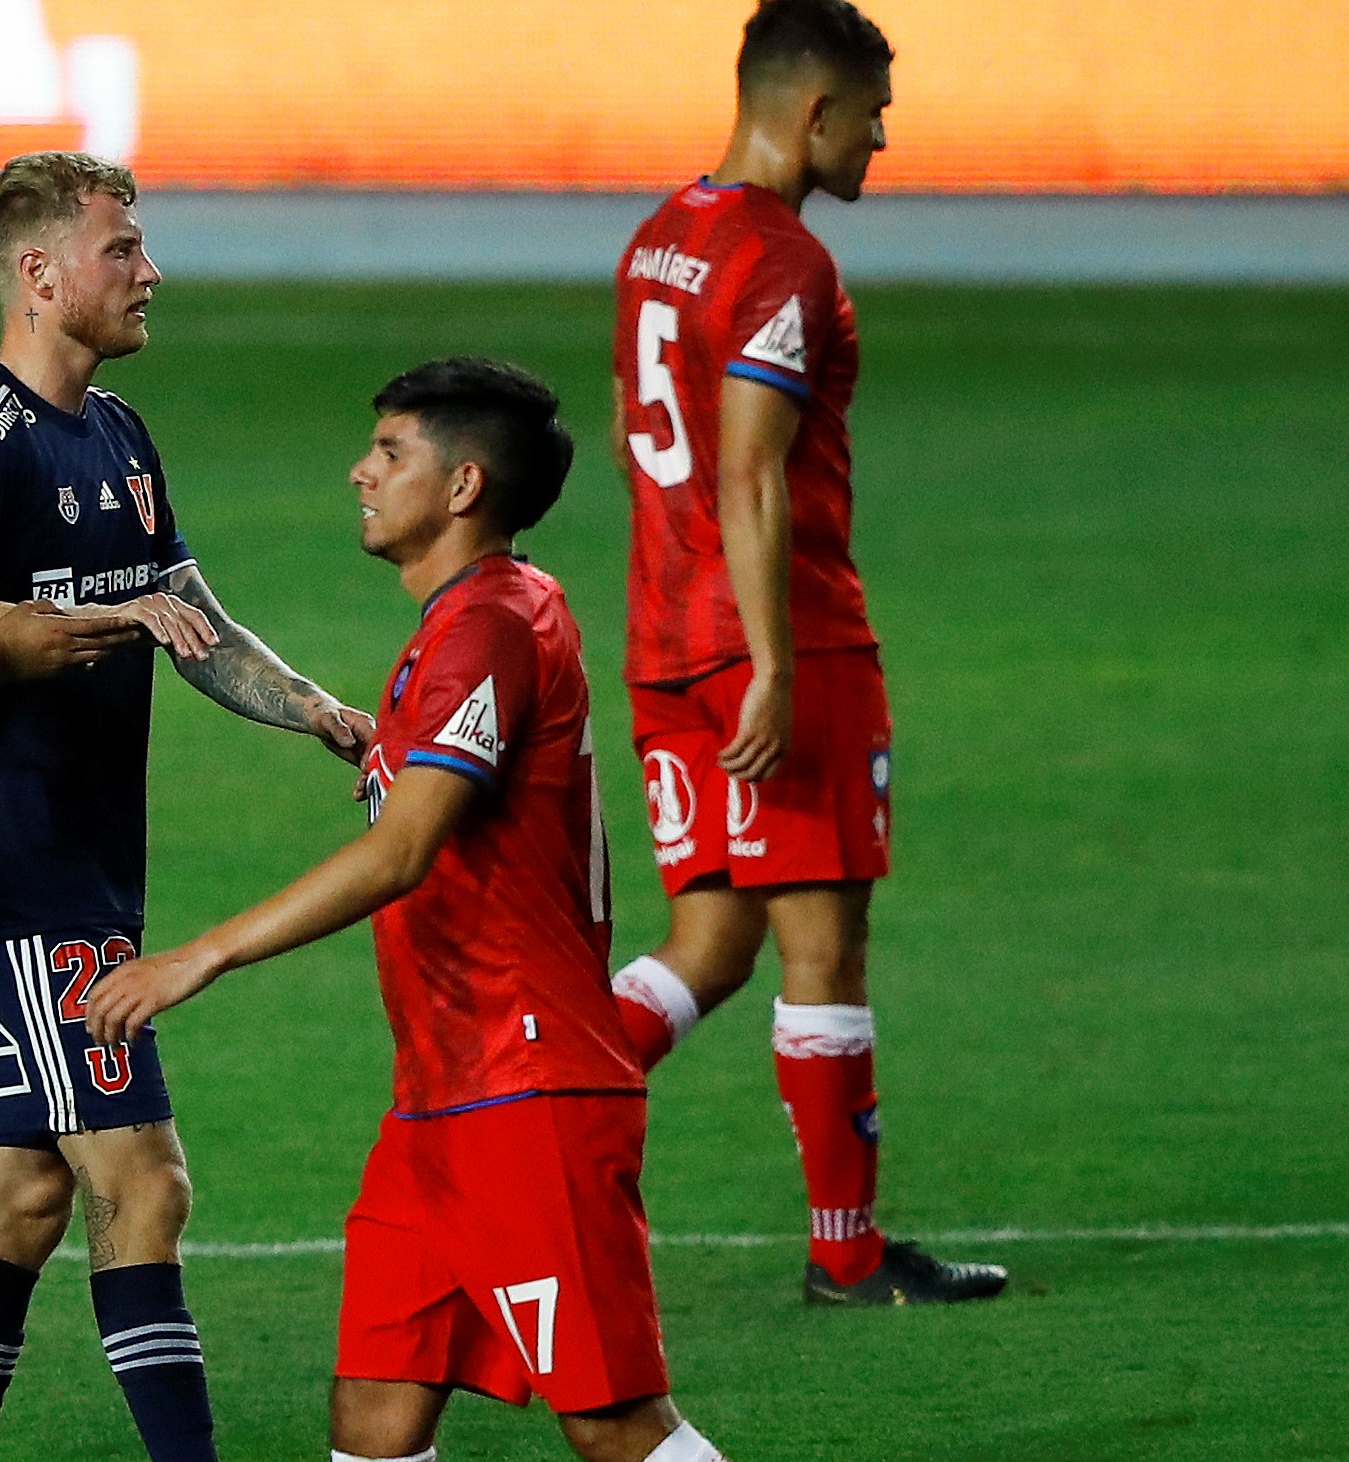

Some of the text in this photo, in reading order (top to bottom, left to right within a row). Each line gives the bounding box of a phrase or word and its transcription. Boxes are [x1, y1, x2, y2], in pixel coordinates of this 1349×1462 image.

[628, 299, 693, 488] 5
[449, 699, 495, 752] Sika
[492, 1276, 560, 1375] 17
